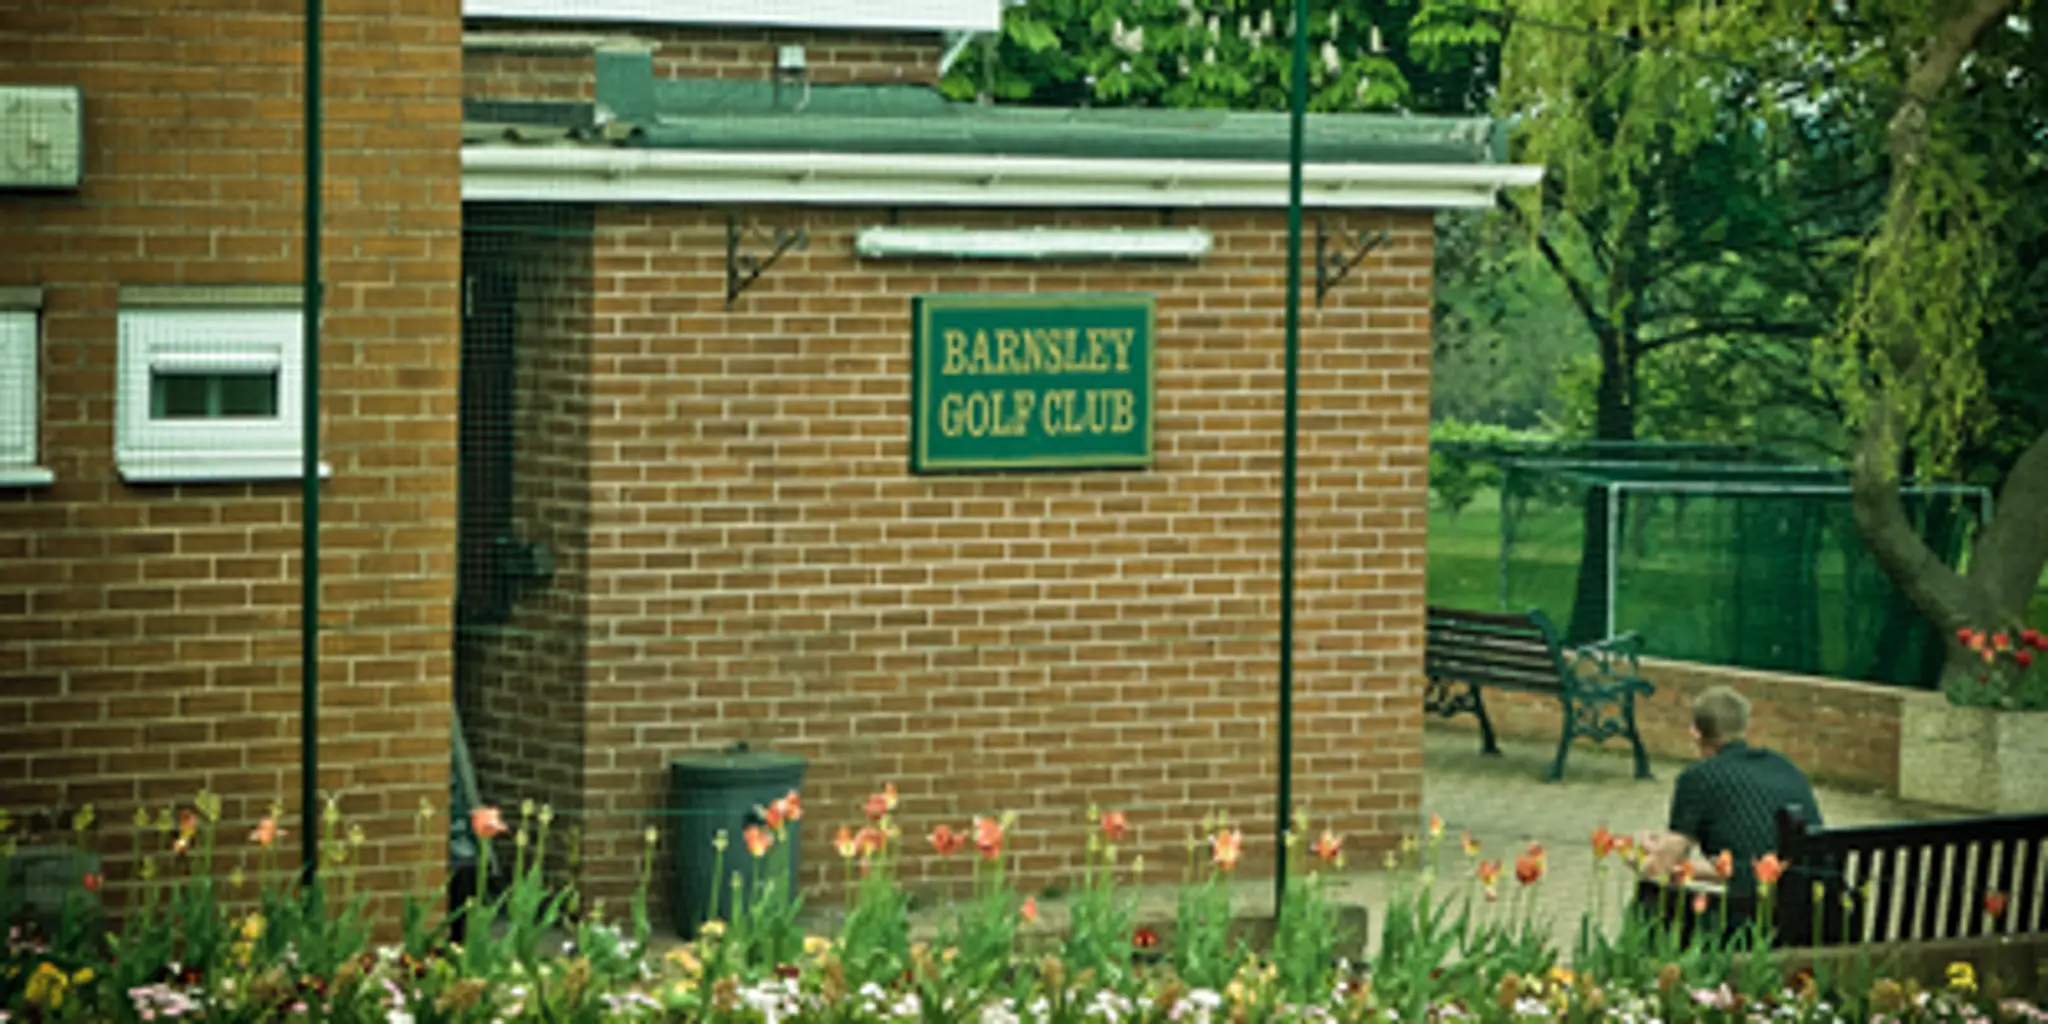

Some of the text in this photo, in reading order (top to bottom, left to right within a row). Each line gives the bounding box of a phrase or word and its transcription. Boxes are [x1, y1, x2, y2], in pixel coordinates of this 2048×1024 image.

[941, 327, 1135, 375] BARNSLEY
[939, 388, 1136, 437] GOLF CLUB
